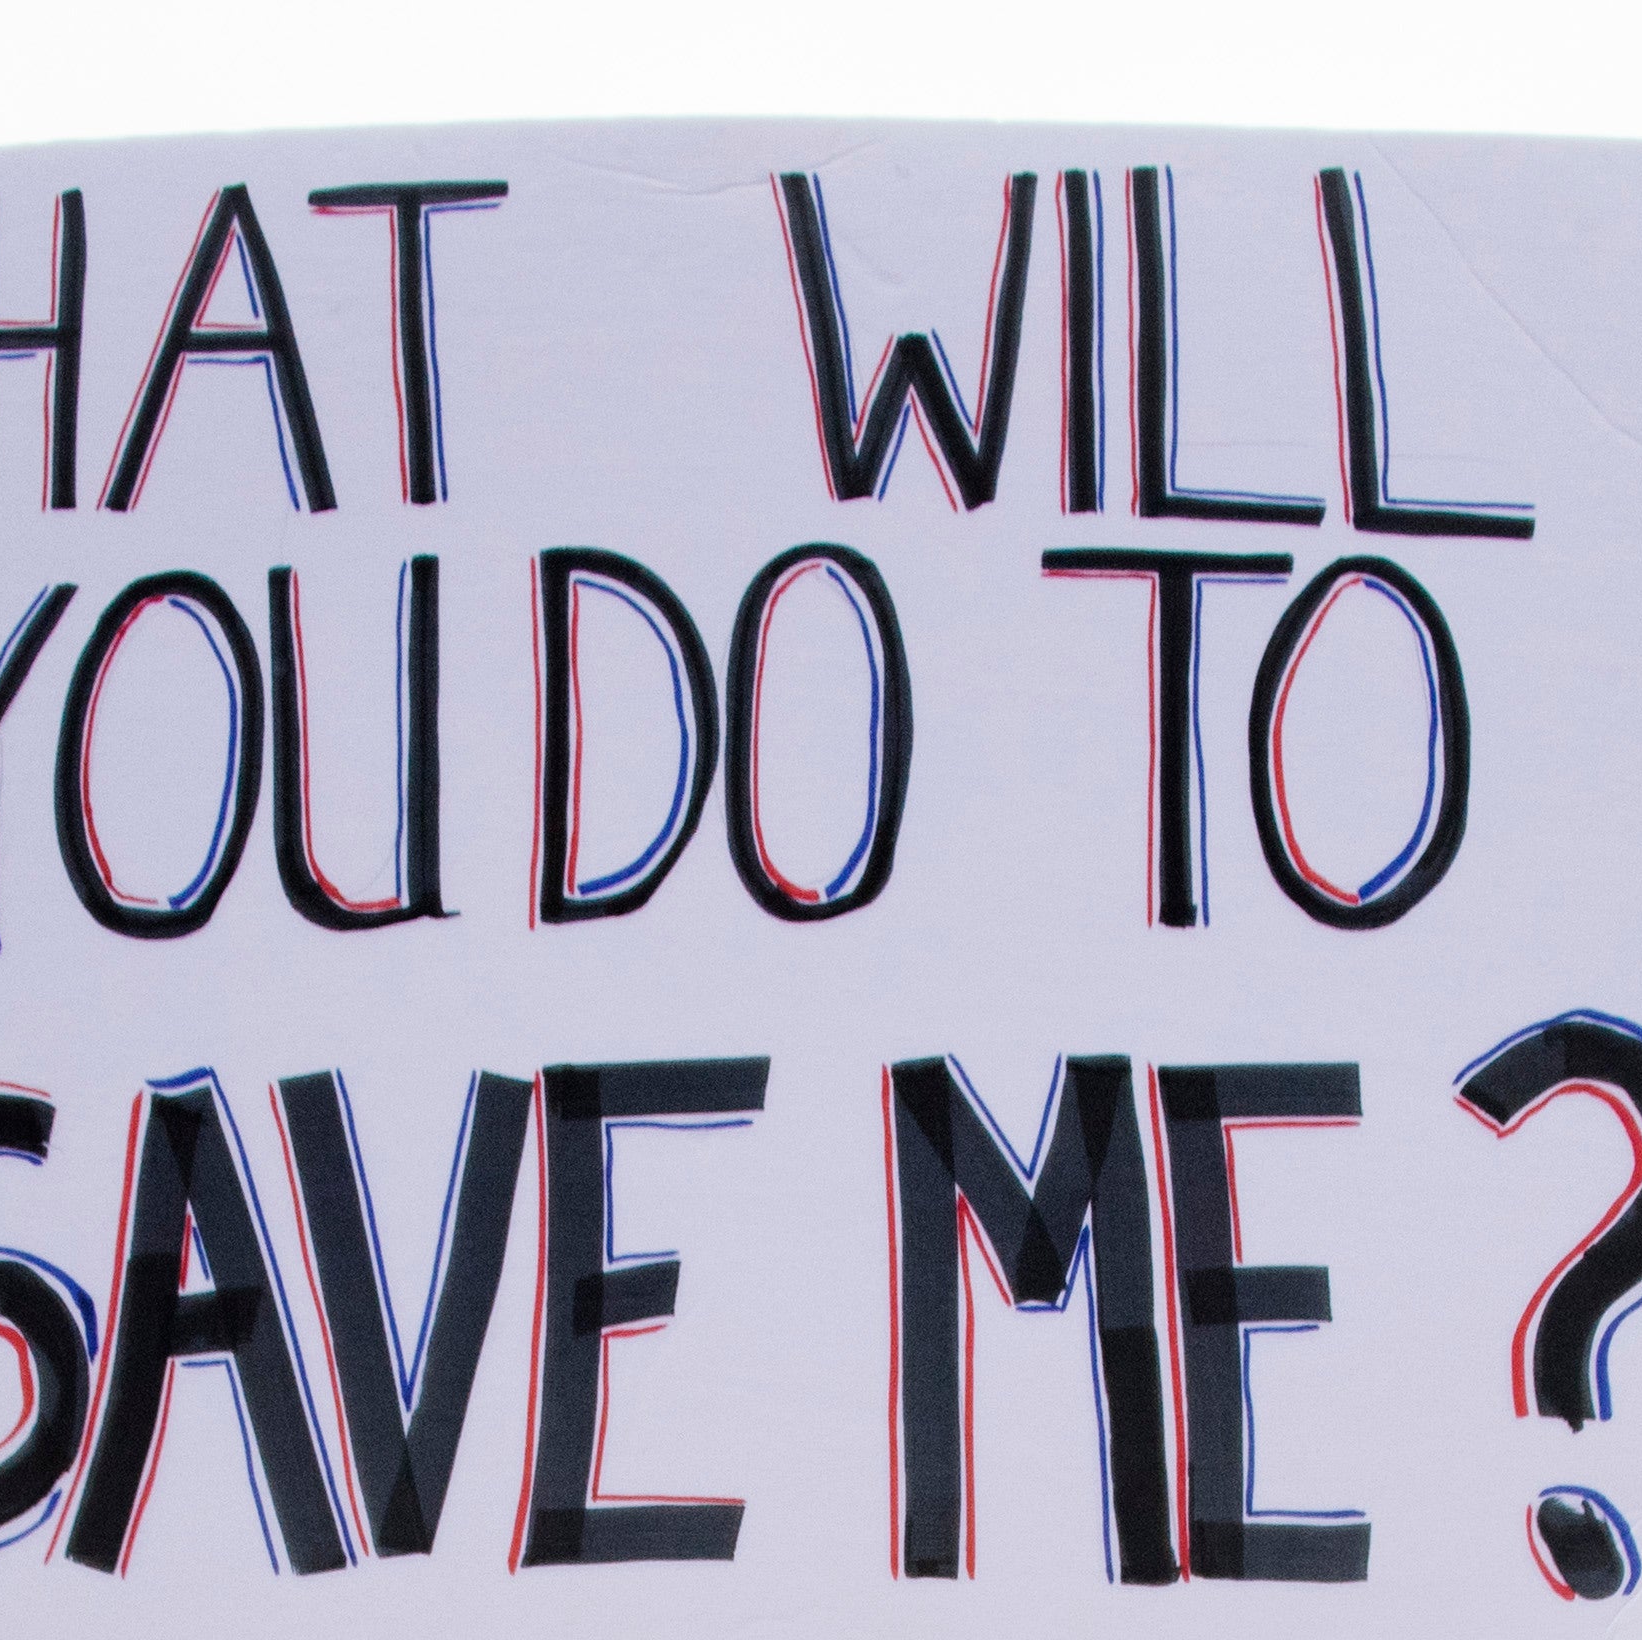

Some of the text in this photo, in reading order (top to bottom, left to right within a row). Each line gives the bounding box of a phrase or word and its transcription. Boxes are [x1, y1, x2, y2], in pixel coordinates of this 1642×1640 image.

[771, 166, 1535, 541] WILL
[527, 542, 913, 932] DO
[1041, 547, 1471, 932] TO
